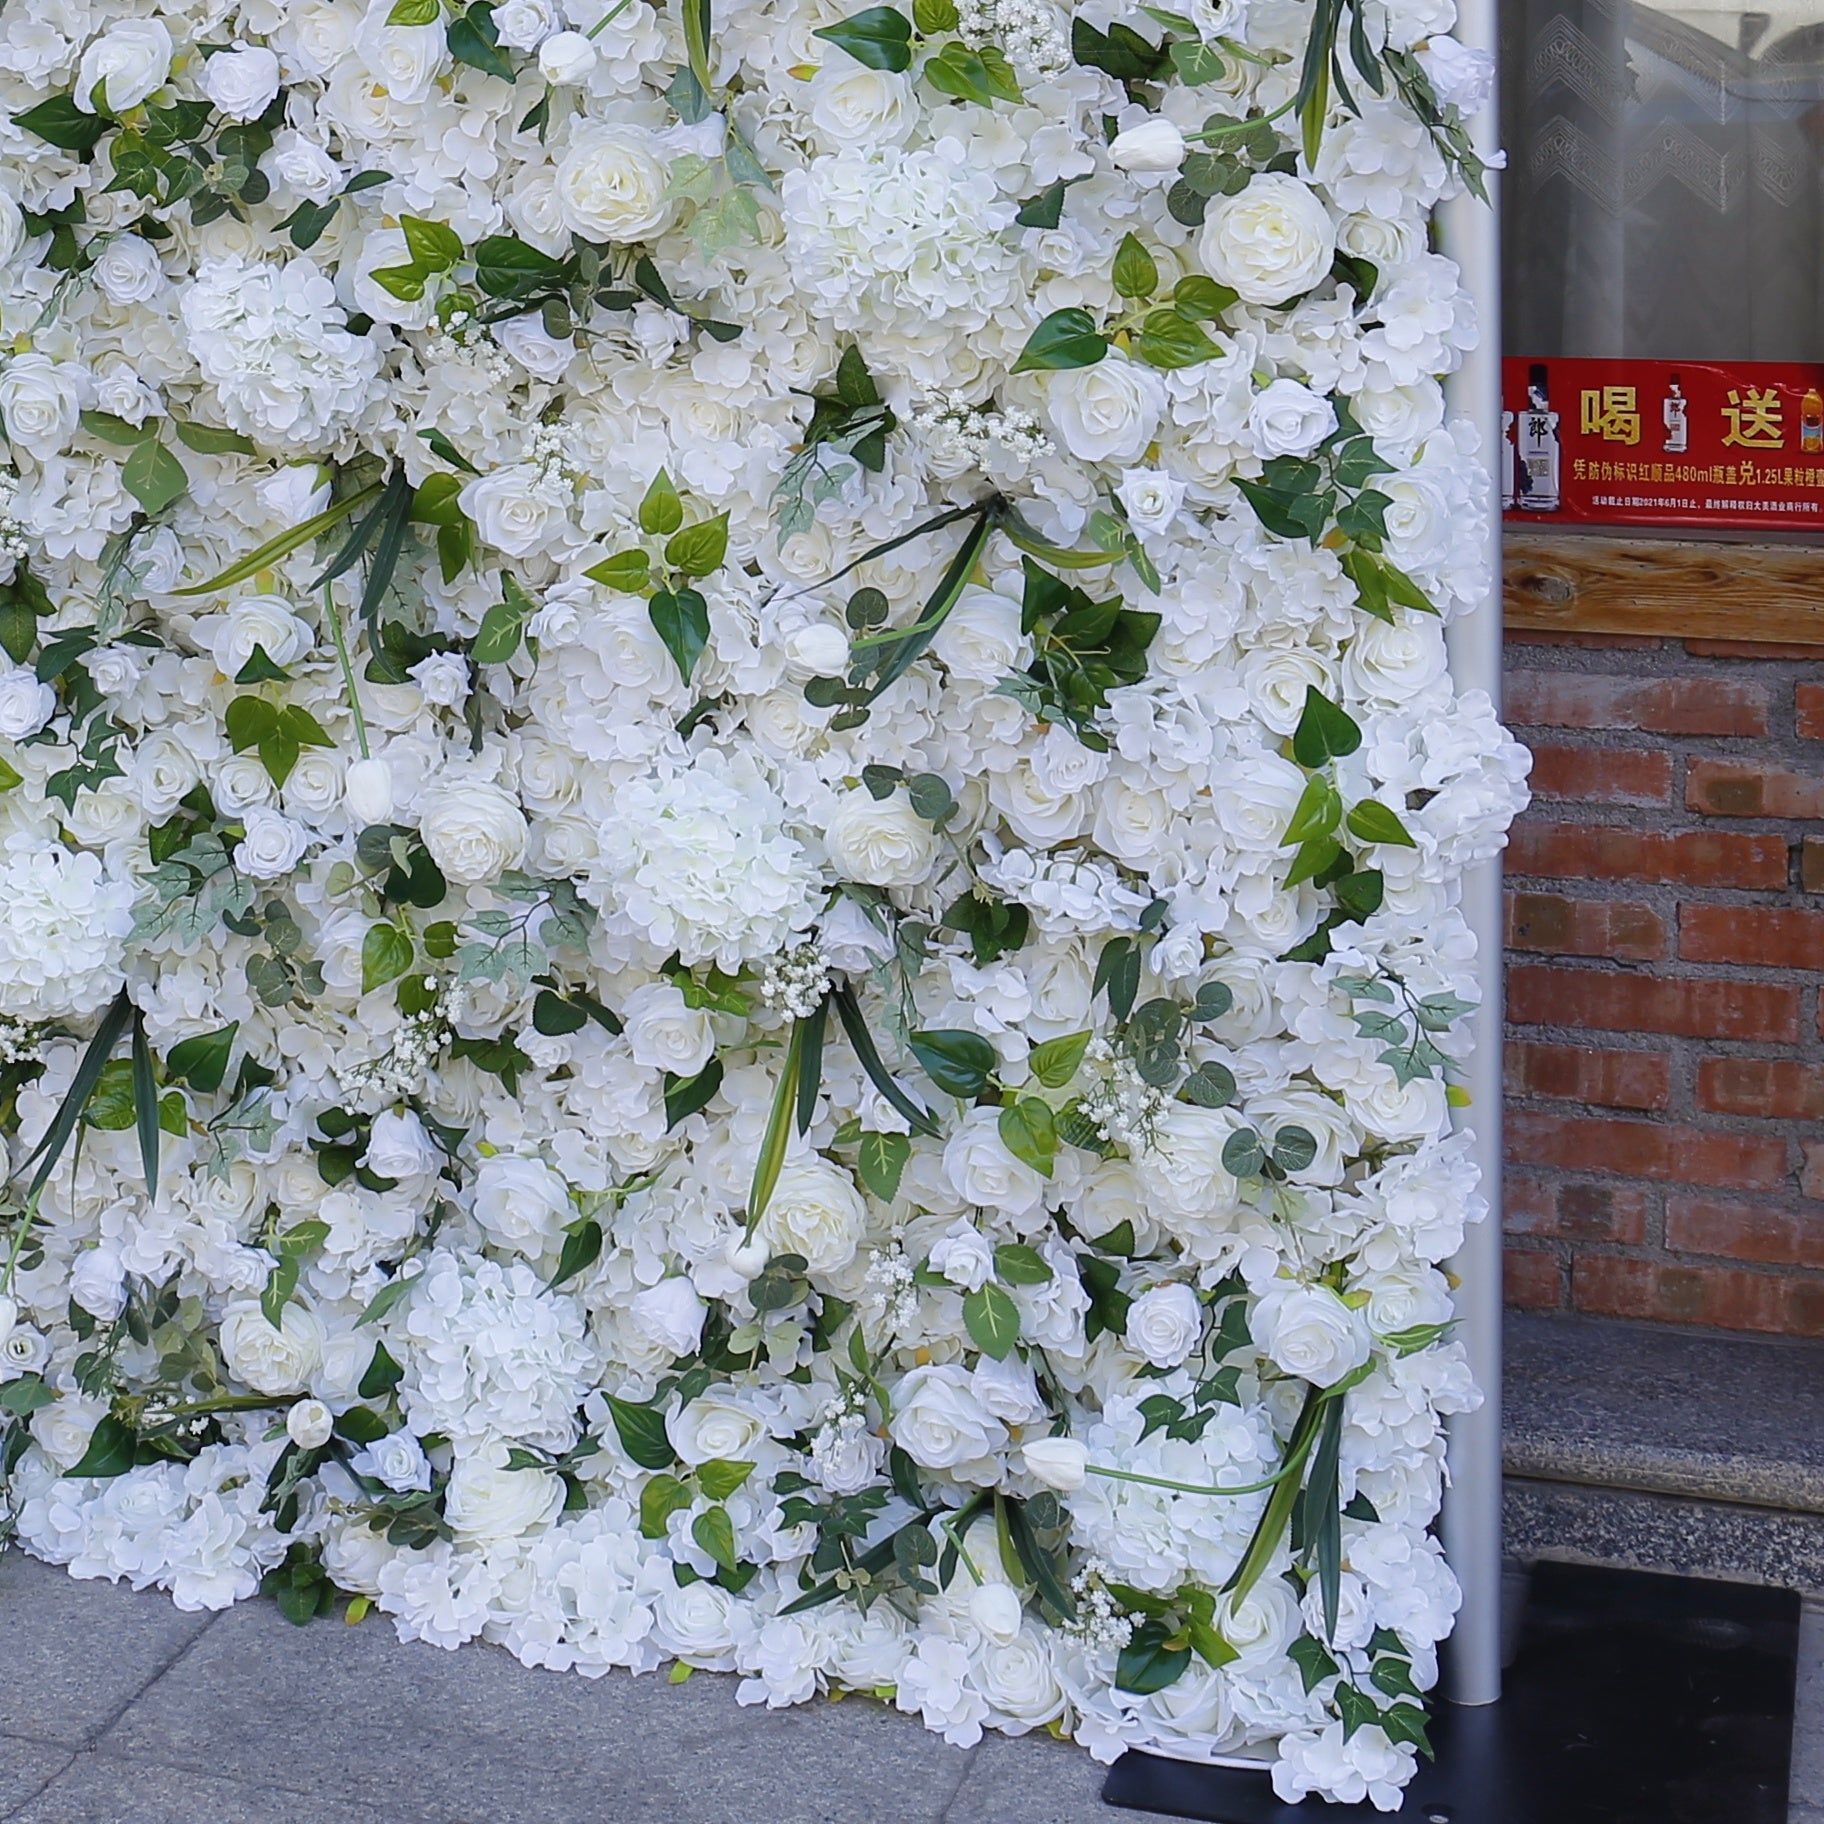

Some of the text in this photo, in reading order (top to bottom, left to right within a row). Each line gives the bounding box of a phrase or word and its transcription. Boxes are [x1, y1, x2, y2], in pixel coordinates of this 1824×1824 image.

[1528, 417, 1548, 448] 郎
[1580, 386, 1785, 449] 喝 送
